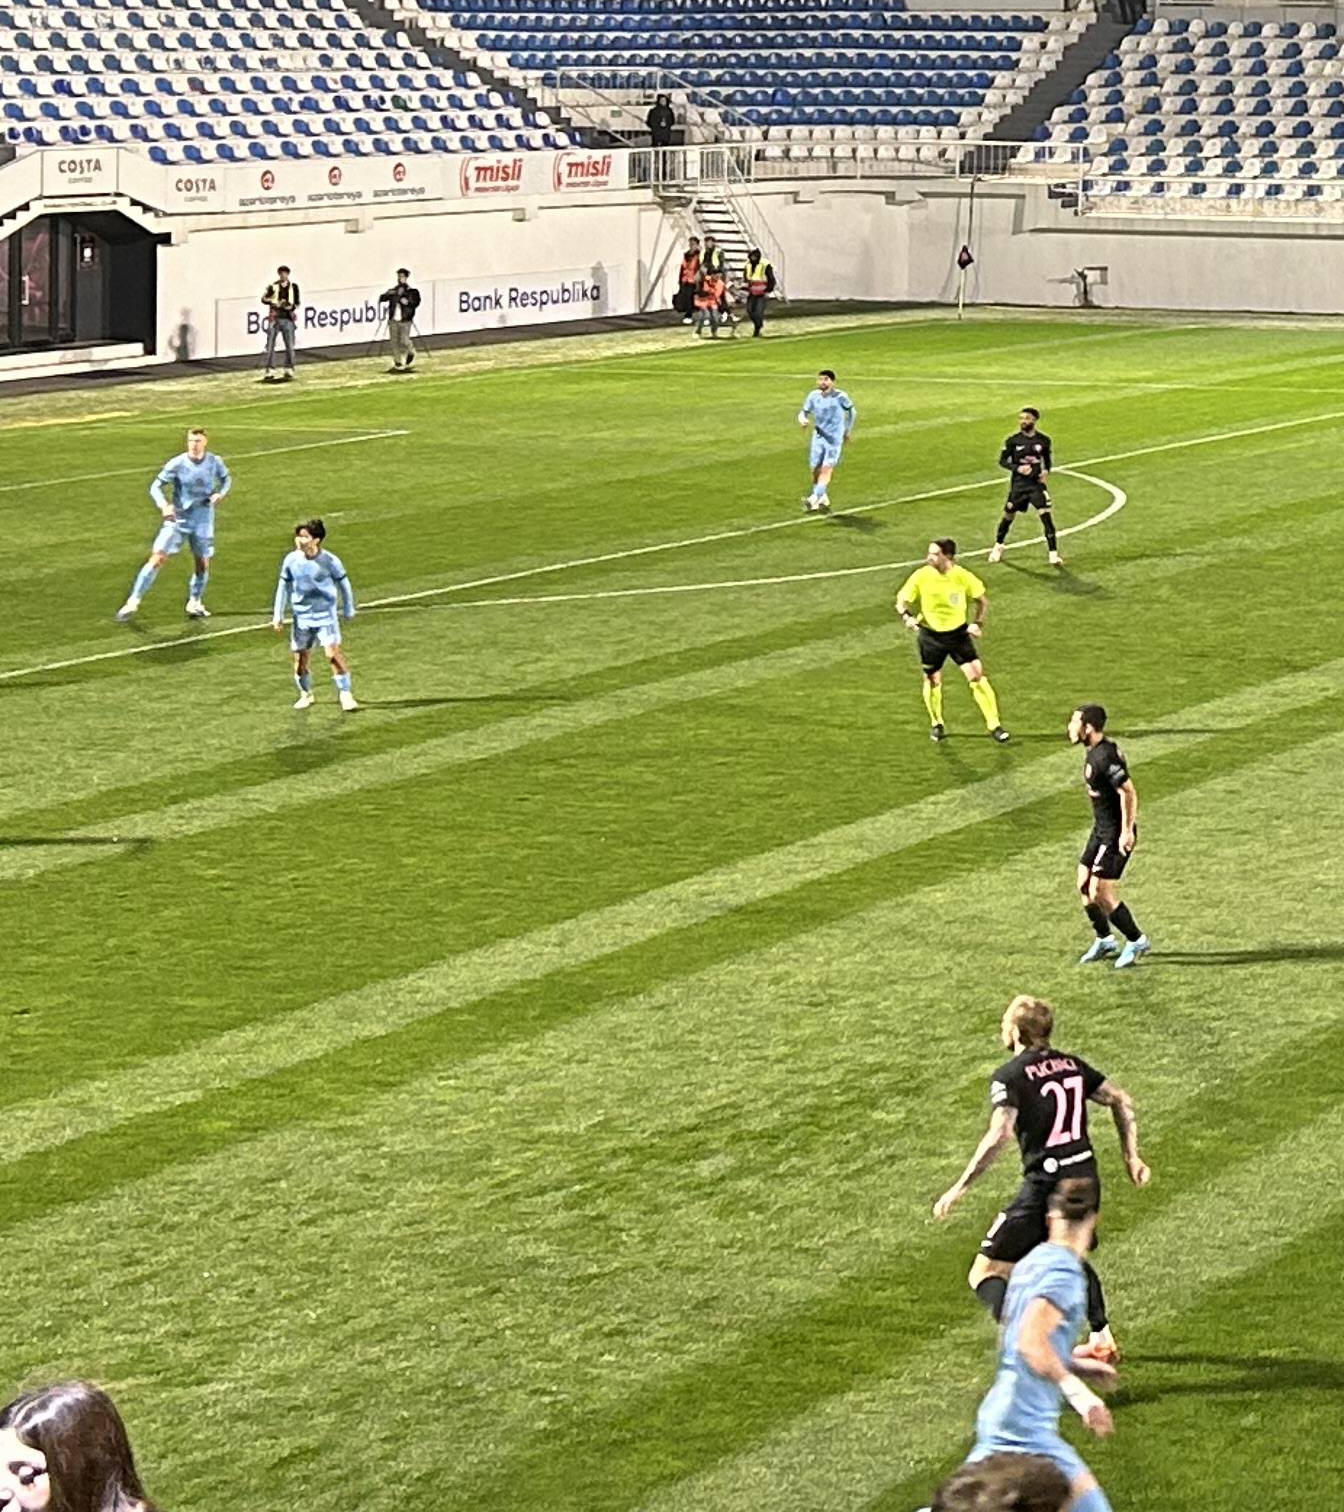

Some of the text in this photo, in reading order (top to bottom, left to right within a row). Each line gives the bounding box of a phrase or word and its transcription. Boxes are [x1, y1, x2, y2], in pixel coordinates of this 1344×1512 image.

[58, 158, 102, 174] COSTA
[474, 157, 524, 183] misli
[566, 153, 612, 178] misli
[175, 178, 217, 193] COSTA
[459, 280, 601, 313] Bank Respublika
[1041, 1075, 1083, 1148] 27
